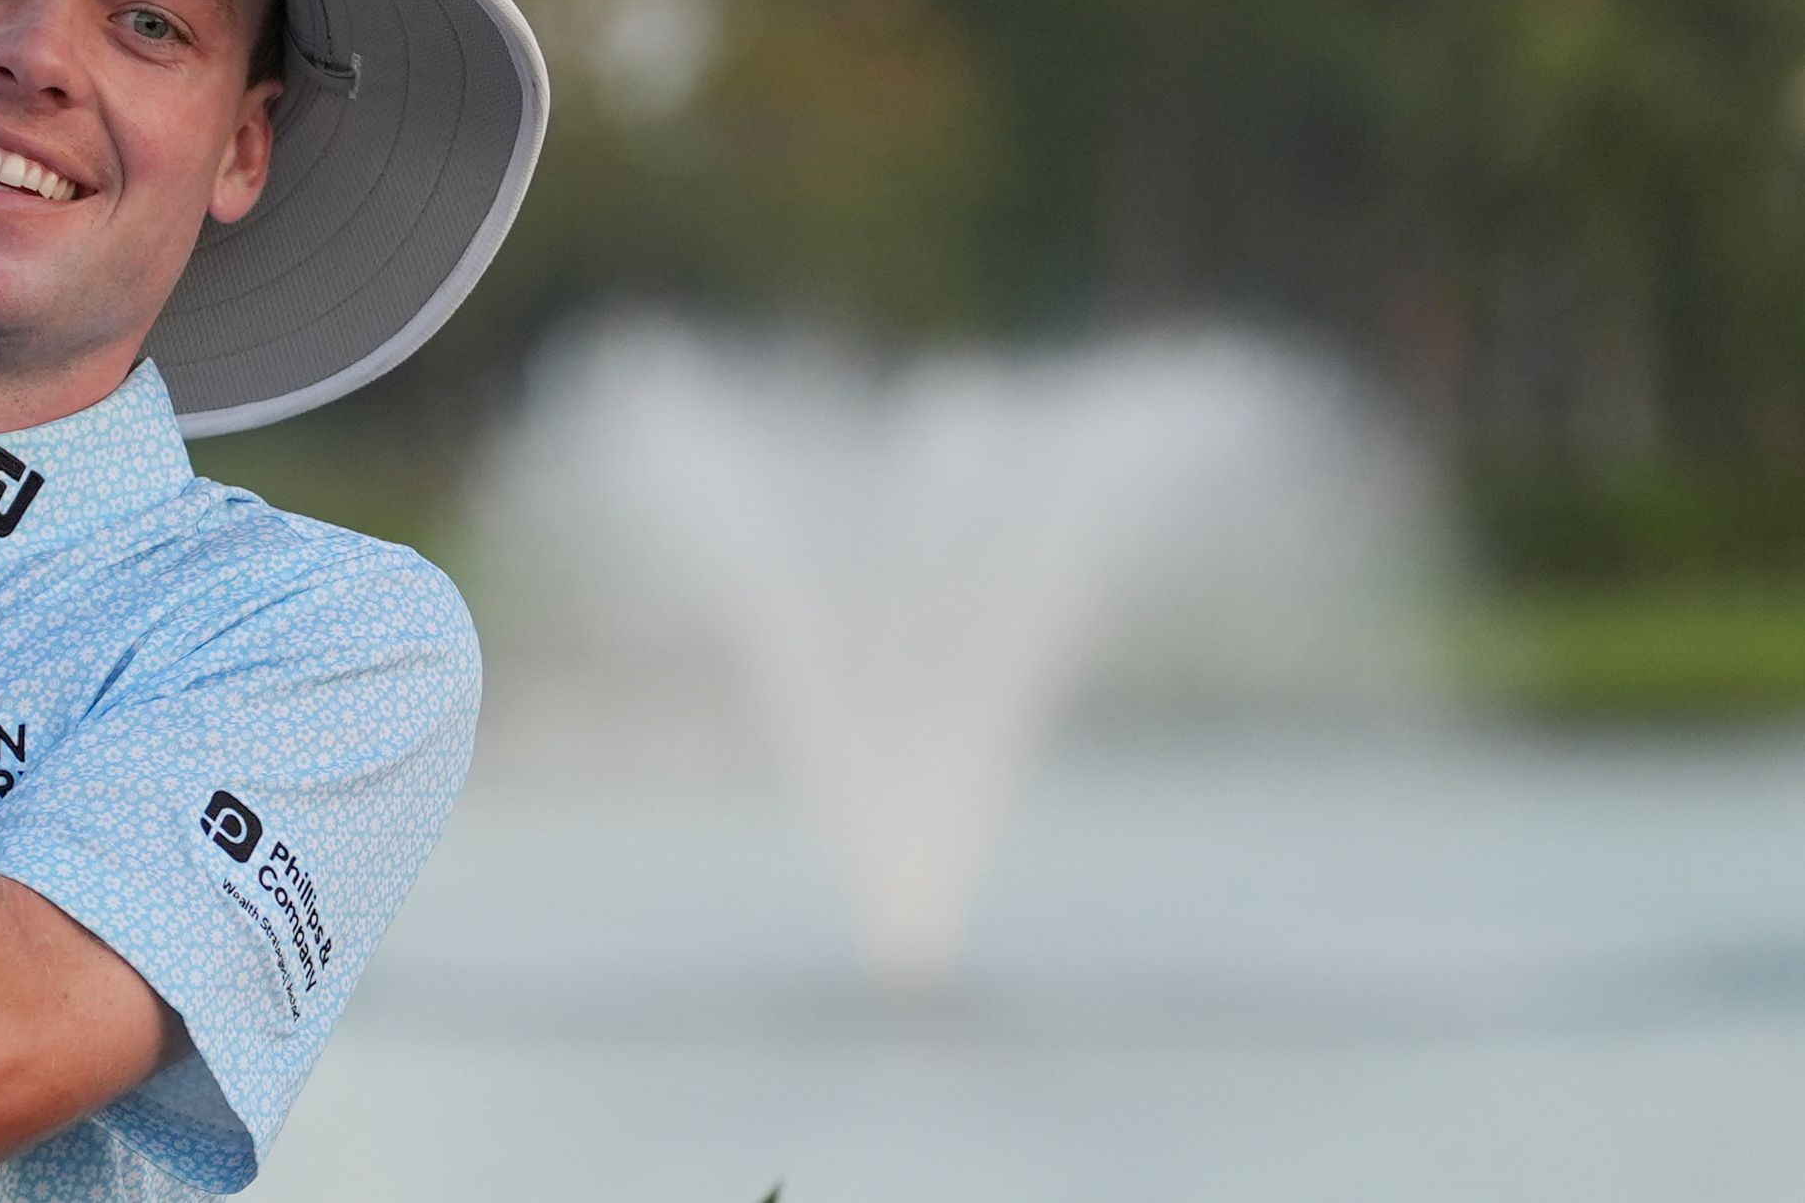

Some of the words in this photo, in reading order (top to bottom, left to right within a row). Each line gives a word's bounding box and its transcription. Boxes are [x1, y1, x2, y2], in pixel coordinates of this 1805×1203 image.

[222, 878, 260, 921] Wealth
[257, 865, 318, 993] Company
[269, 840, 323, 945] Phillips
